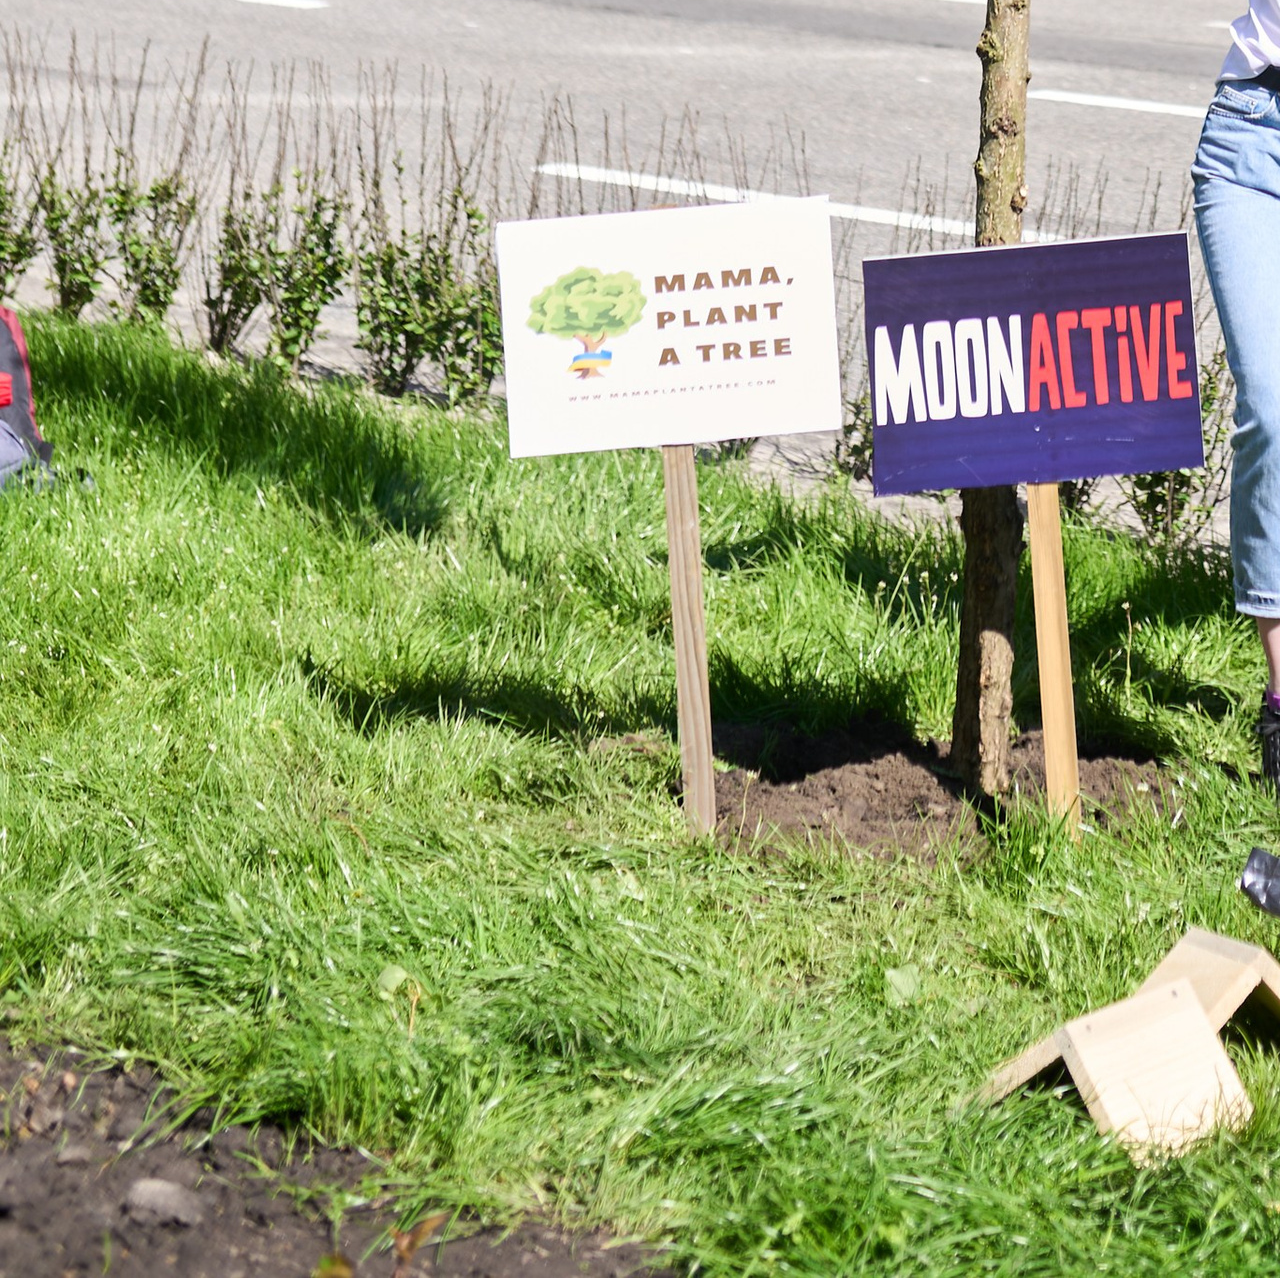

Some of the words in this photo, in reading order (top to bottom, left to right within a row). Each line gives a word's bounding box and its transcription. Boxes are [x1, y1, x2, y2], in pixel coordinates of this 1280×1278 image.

[654, 266, 794, 293] MAMA,
[657, 302, 783, 330] PLANT
[658, 347, 680, 366] A
[696, 338, 792, 363] TREE
